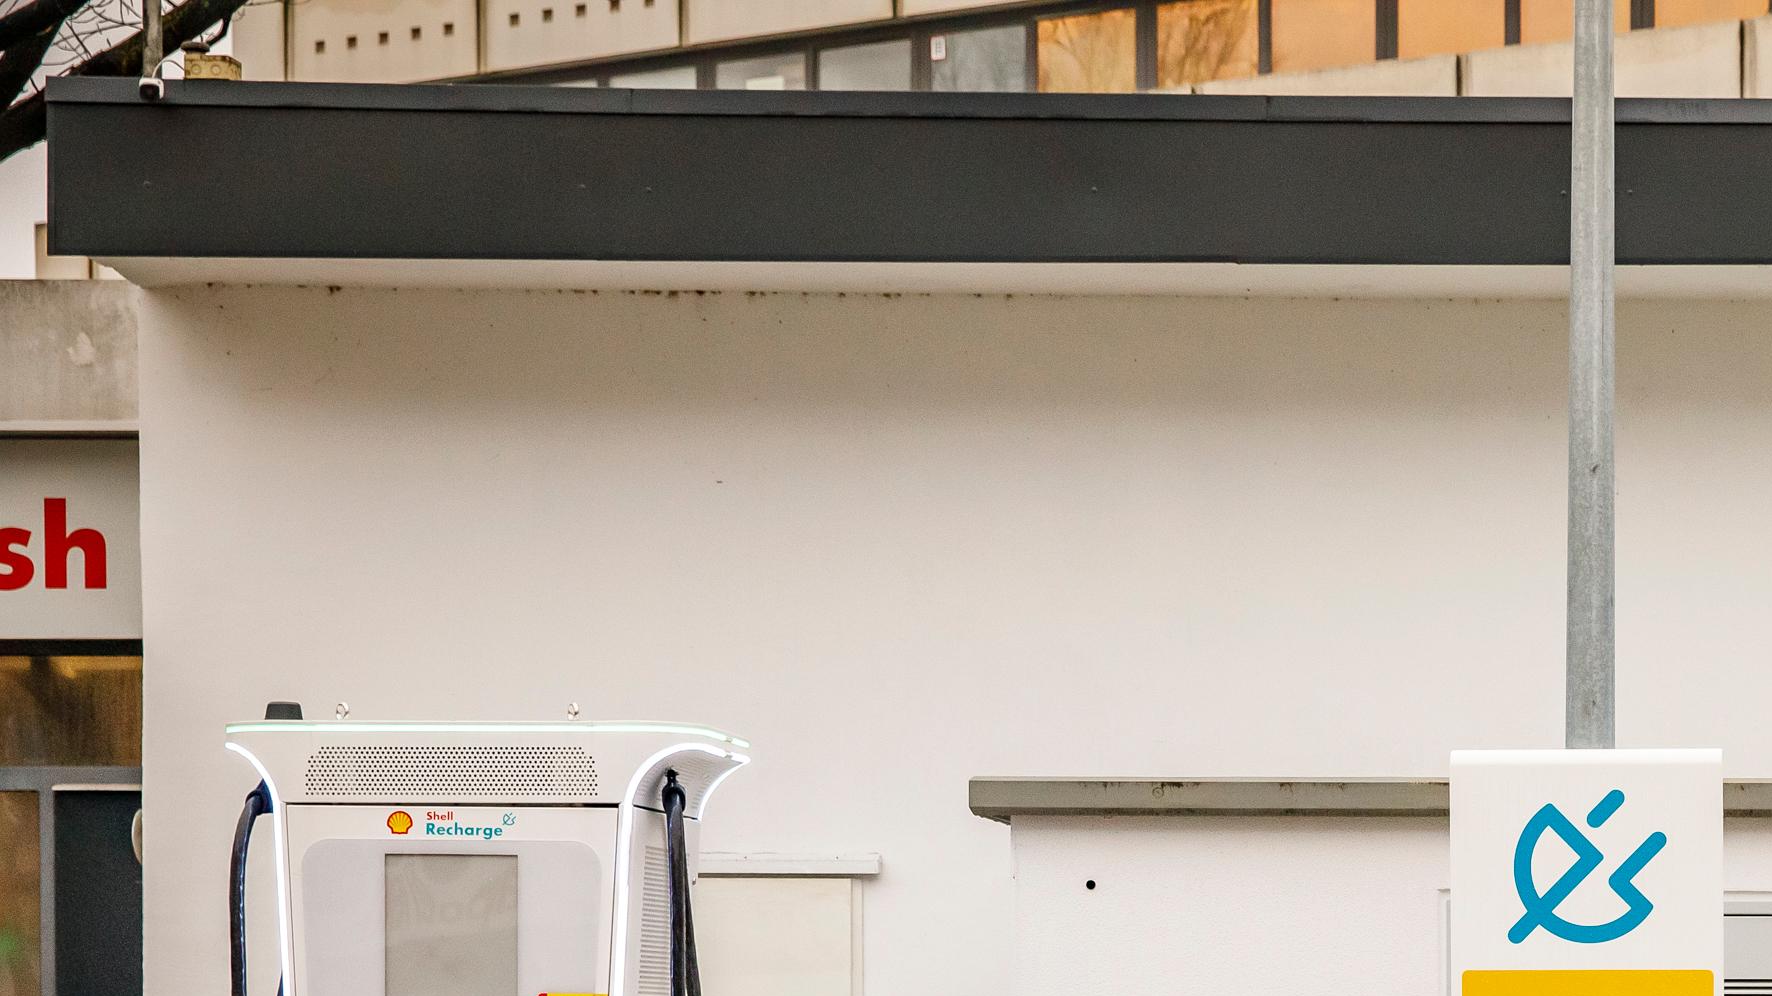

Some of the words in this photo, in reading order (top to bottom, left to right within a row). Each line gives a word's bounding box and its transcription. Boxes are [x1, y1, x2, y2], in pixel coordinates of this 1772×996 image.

[0, 497, 107, 590] sh
[426, 811, 453, 821] Shell
[425, 822, 503, 839] Recharge
